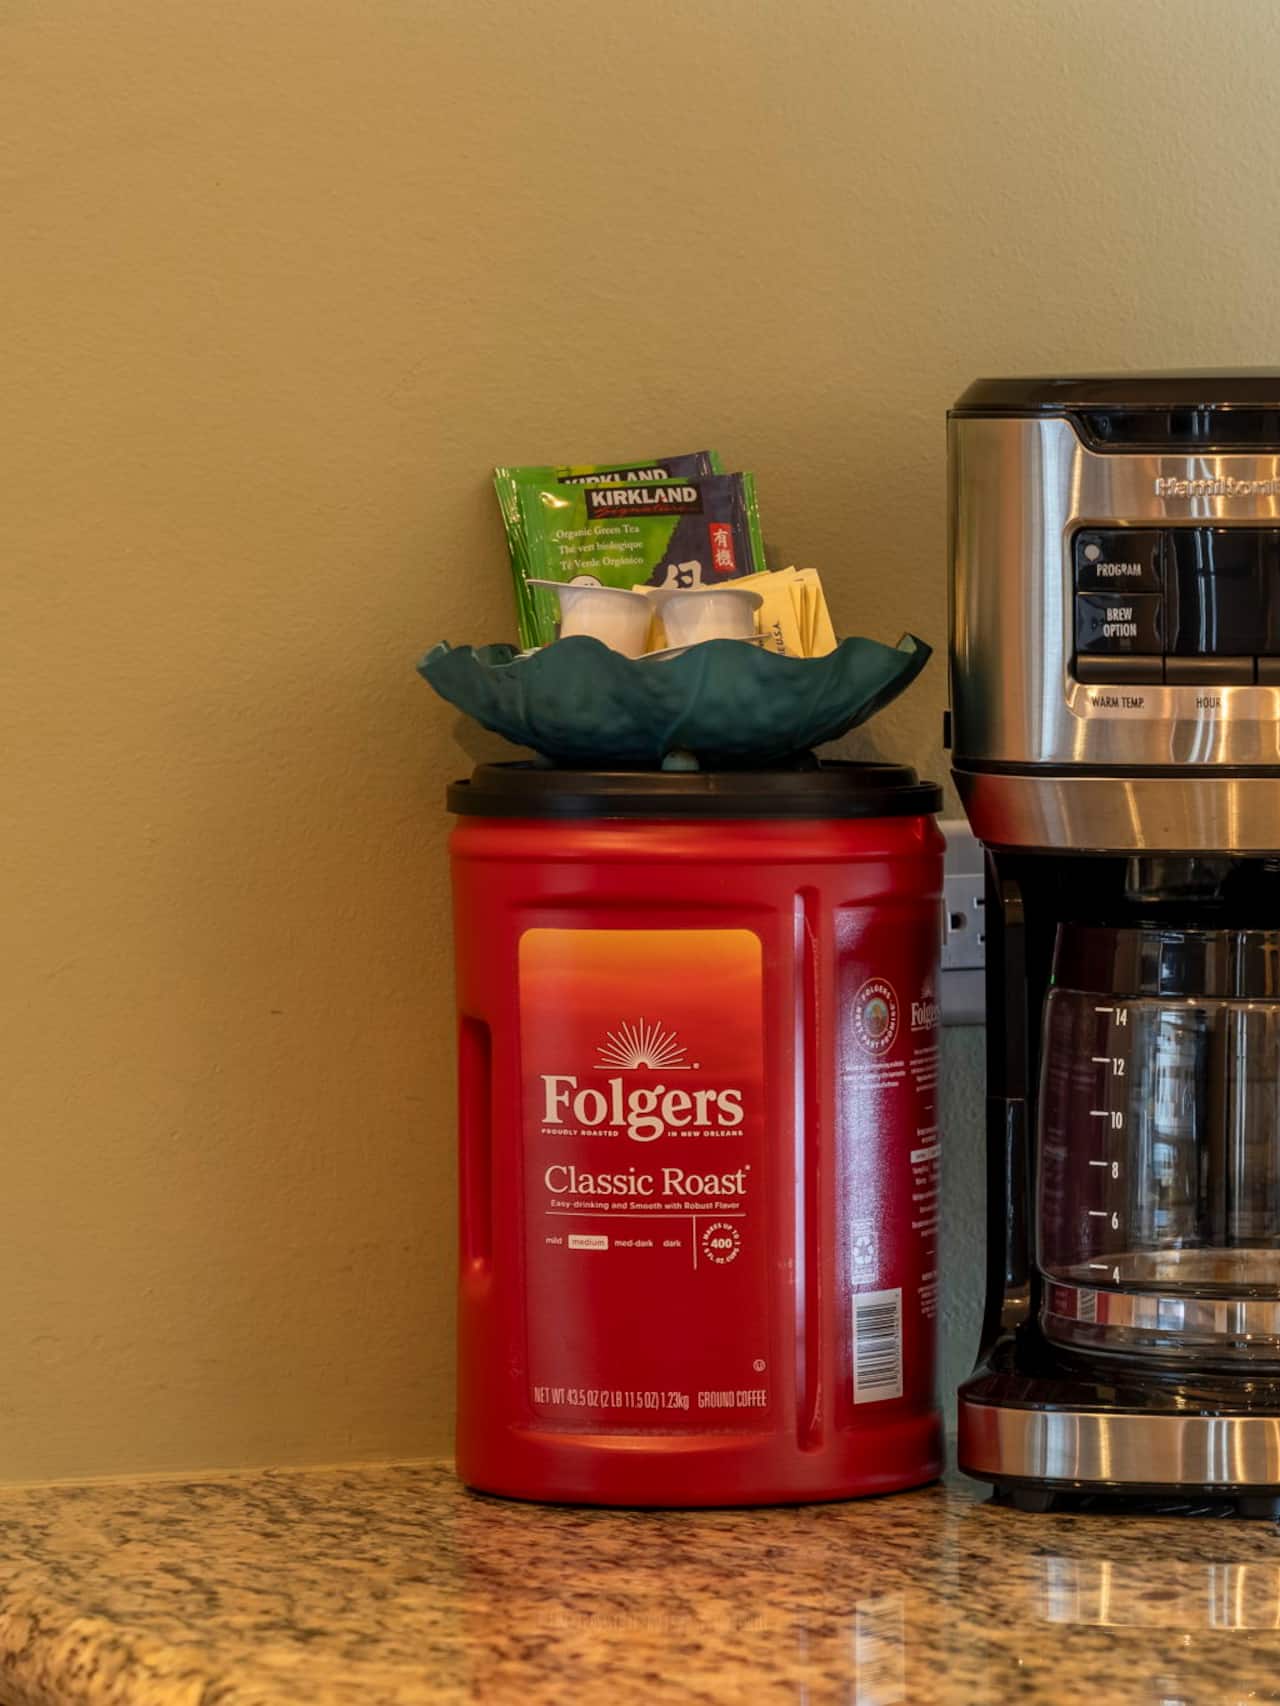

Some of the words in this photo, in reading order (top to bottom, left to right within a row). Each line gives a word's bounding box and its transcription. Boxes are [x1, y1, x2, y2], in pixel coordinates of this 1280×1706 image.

[565, 469, 669, 484] RKLAND
[592, 487, 697, 507] KIRKLAND
[556, 528, 592, 540] Organic
[594, 526, 620, 536] Green
[622, 523, 639, 534] Tea
[575, 558, 600, 567] Verde
[1096, 563, 1142, 577] PROGRAM
[1106, 608, 1133, 622] BREW
[1103, 623, 1138, 638] OPTION
[1091, 696, 1119, 709] WARM
[1195, 697, 1222, 710] HOUR
[861, 984, 892, 1001] FOLGERS
[1115, 1007, 1128, 1026] 14
[1112, 1057, 1125, 1076] 12
[540, 1074, 745, 1142] Folgers
[1110, 1110, 1123, 1130] 10
[541, 1128, 578, 1136] PROUDLY
[580, 1129, 619, 1137] ROASTED
[703, 1129, 744, 1137] ORLEANS
[1111, 1161, 1119, 1179] 8
[544, 1164, 653, 1196] Classic
[551, 1199, 609, 1211] Easy-drinking
[611, 1202, 628, 1210] and
[629, 1202, 663, 1210] Smooth
[664, 1202, 682, 1210] with
[684, 1202, 713, 1210] Robust
[714, 1202, 740, 1210] Flavor
[1111, 1211, 1119, 1230] 6
[545, 1236, 563, 1245] mild
[571, 1239, 606, 1248] medium
[614, 1240, 653, 1248] med-dark
[663, 1239, 681, 1248] dark
[710, 1238, 733, 1249] 400
[1112, 1266, 1120, 1284] 4
[534, 1386, 550, 1404] NET
[551, 1387, 565, 1405] WT
[587, 1389, 599, 1408] OZ
[600, 1390, 610, 1409] (2
[610, 1390, 623, 1408] LB
[625, 1391, 644, 1409] 11.5
[644, 1391, 659, 1411] OZ)
[660, 1391, 690, 1411] 1.23kg
[698, 1391, 735, 1409] GROUND
[736, 1389, 767, 1407] COFFEE
